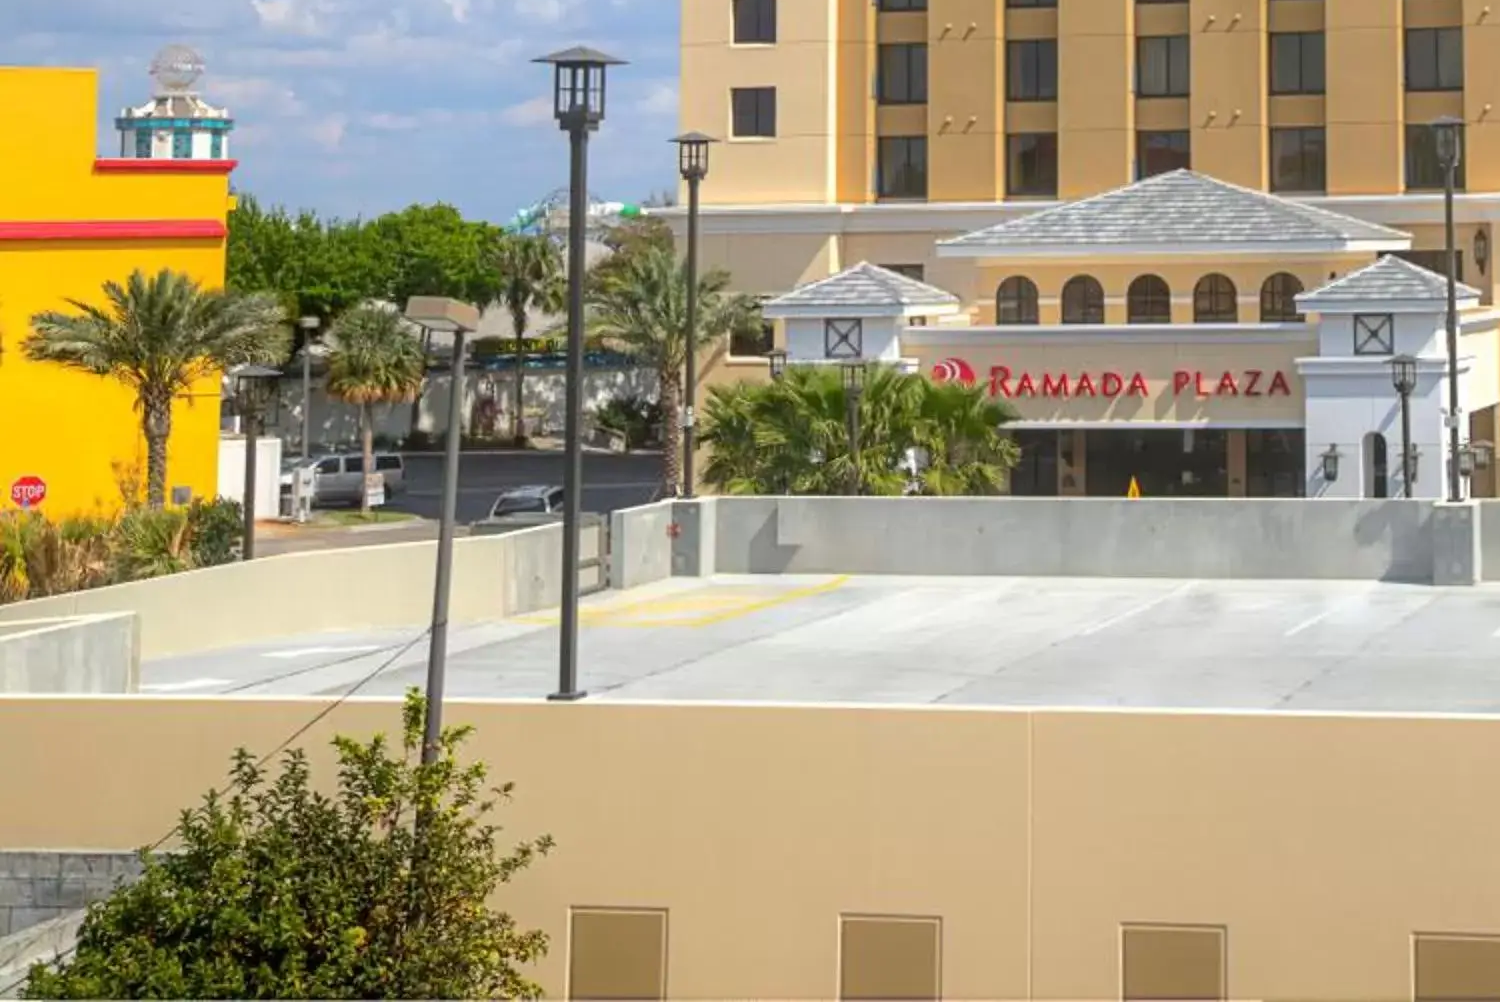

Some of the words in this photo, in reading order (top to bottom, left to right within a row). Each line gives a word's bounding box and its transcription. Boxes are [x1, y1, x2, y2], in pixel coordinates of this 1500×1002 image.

[988, 365, 1149, 398] RAMADA
[1172, 368, 1292, 397] PLAZA
[13, 485, 45, 499] STOP
